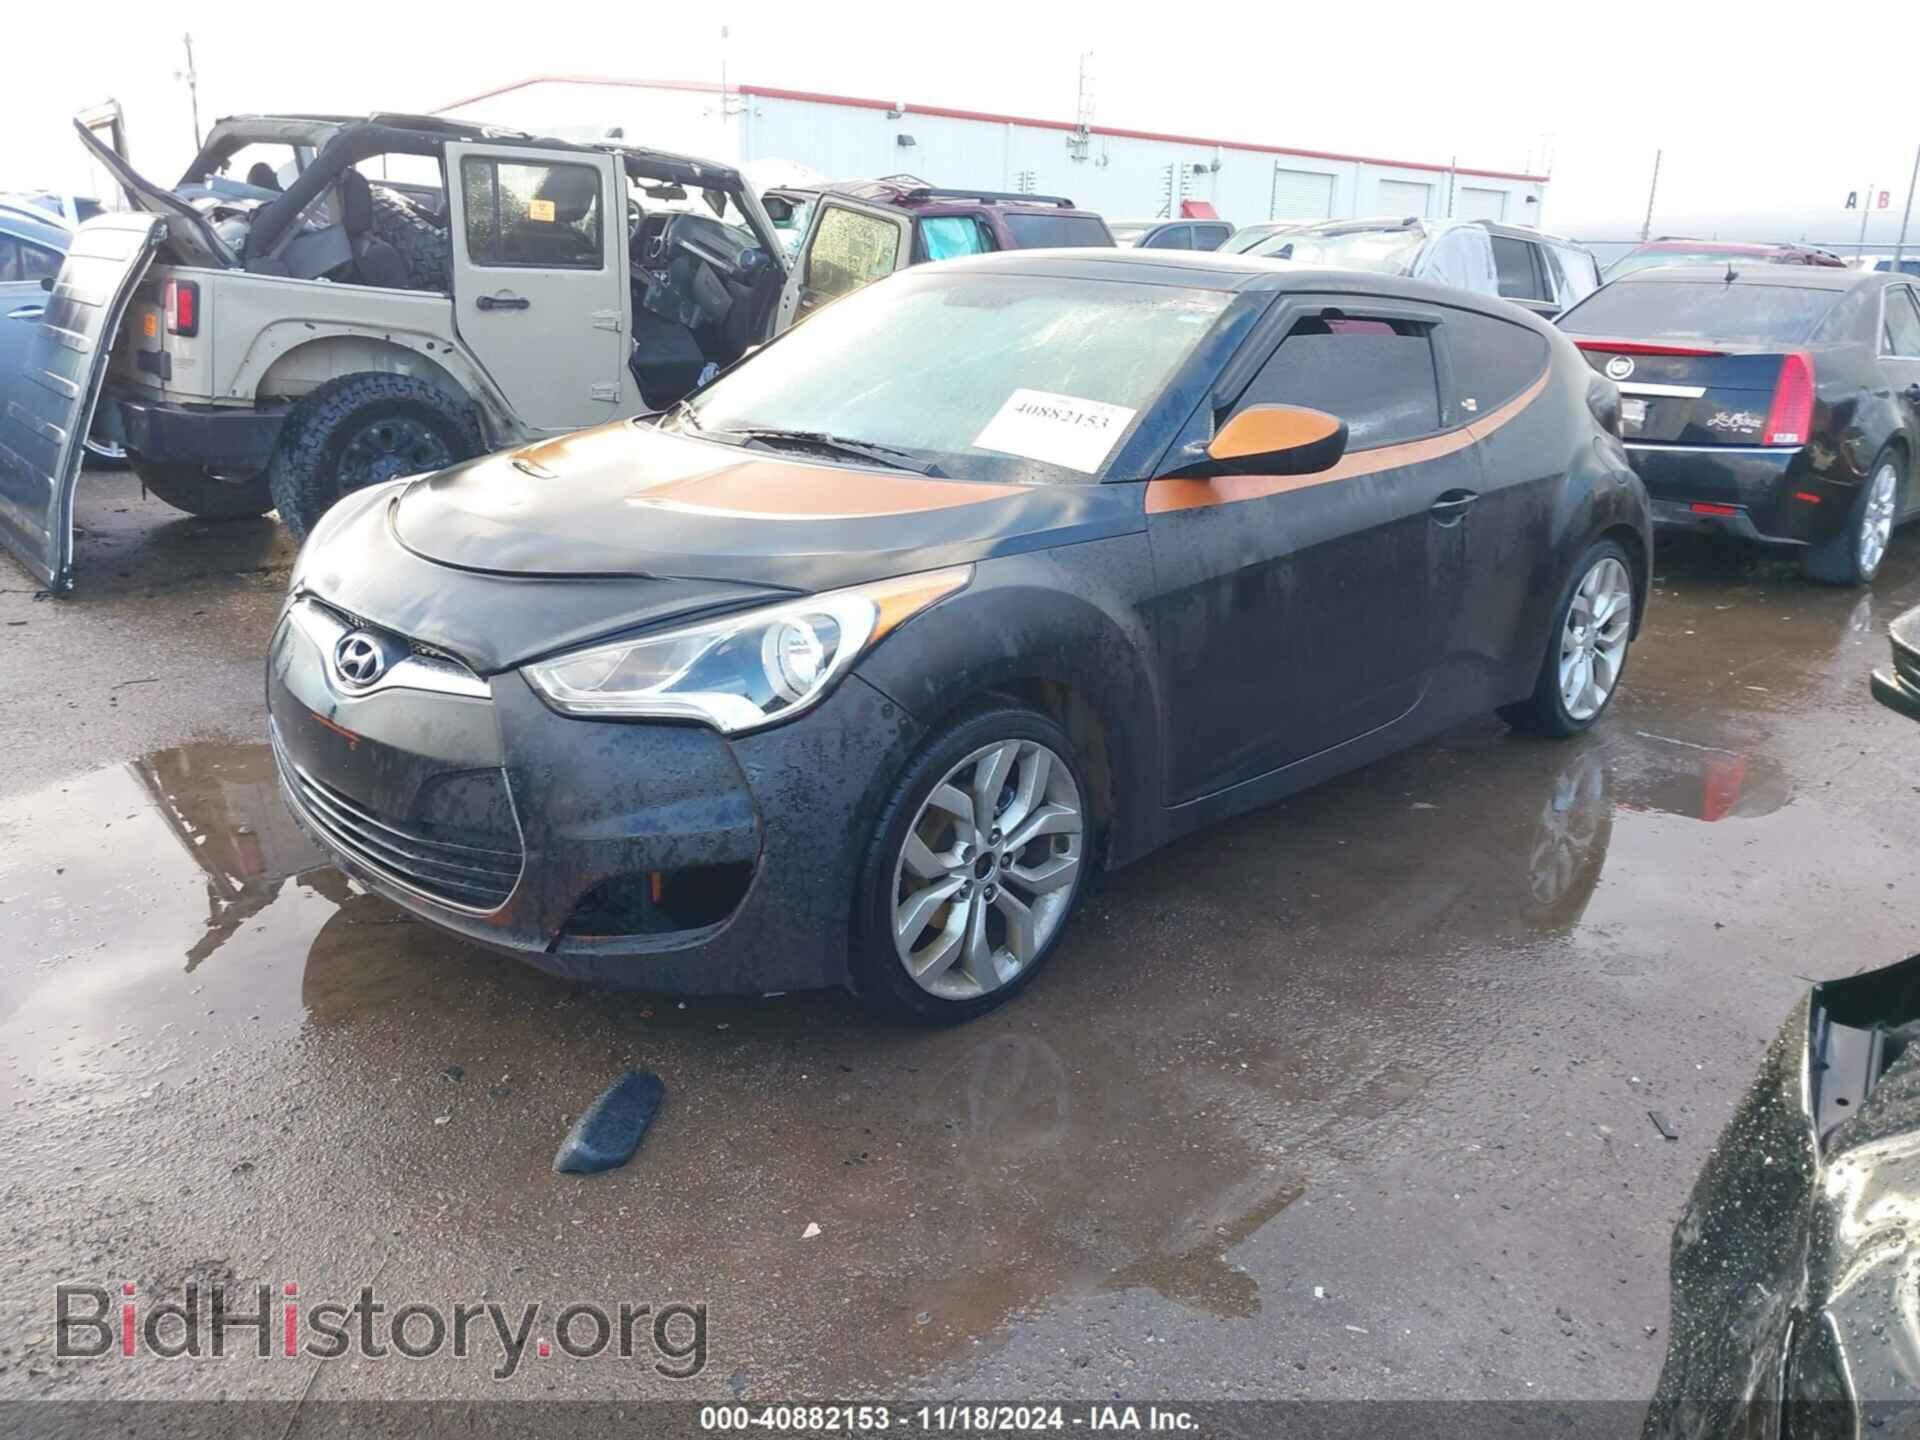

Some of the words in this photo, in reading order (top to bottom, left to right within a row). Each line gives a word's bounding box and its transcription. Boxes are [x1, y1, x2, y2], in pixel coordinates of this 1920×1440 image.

[1845, 191, 1857, 209] A
[1878, 191, 1890, 209] B
[1015, 402, 1110, 429] 40882153
